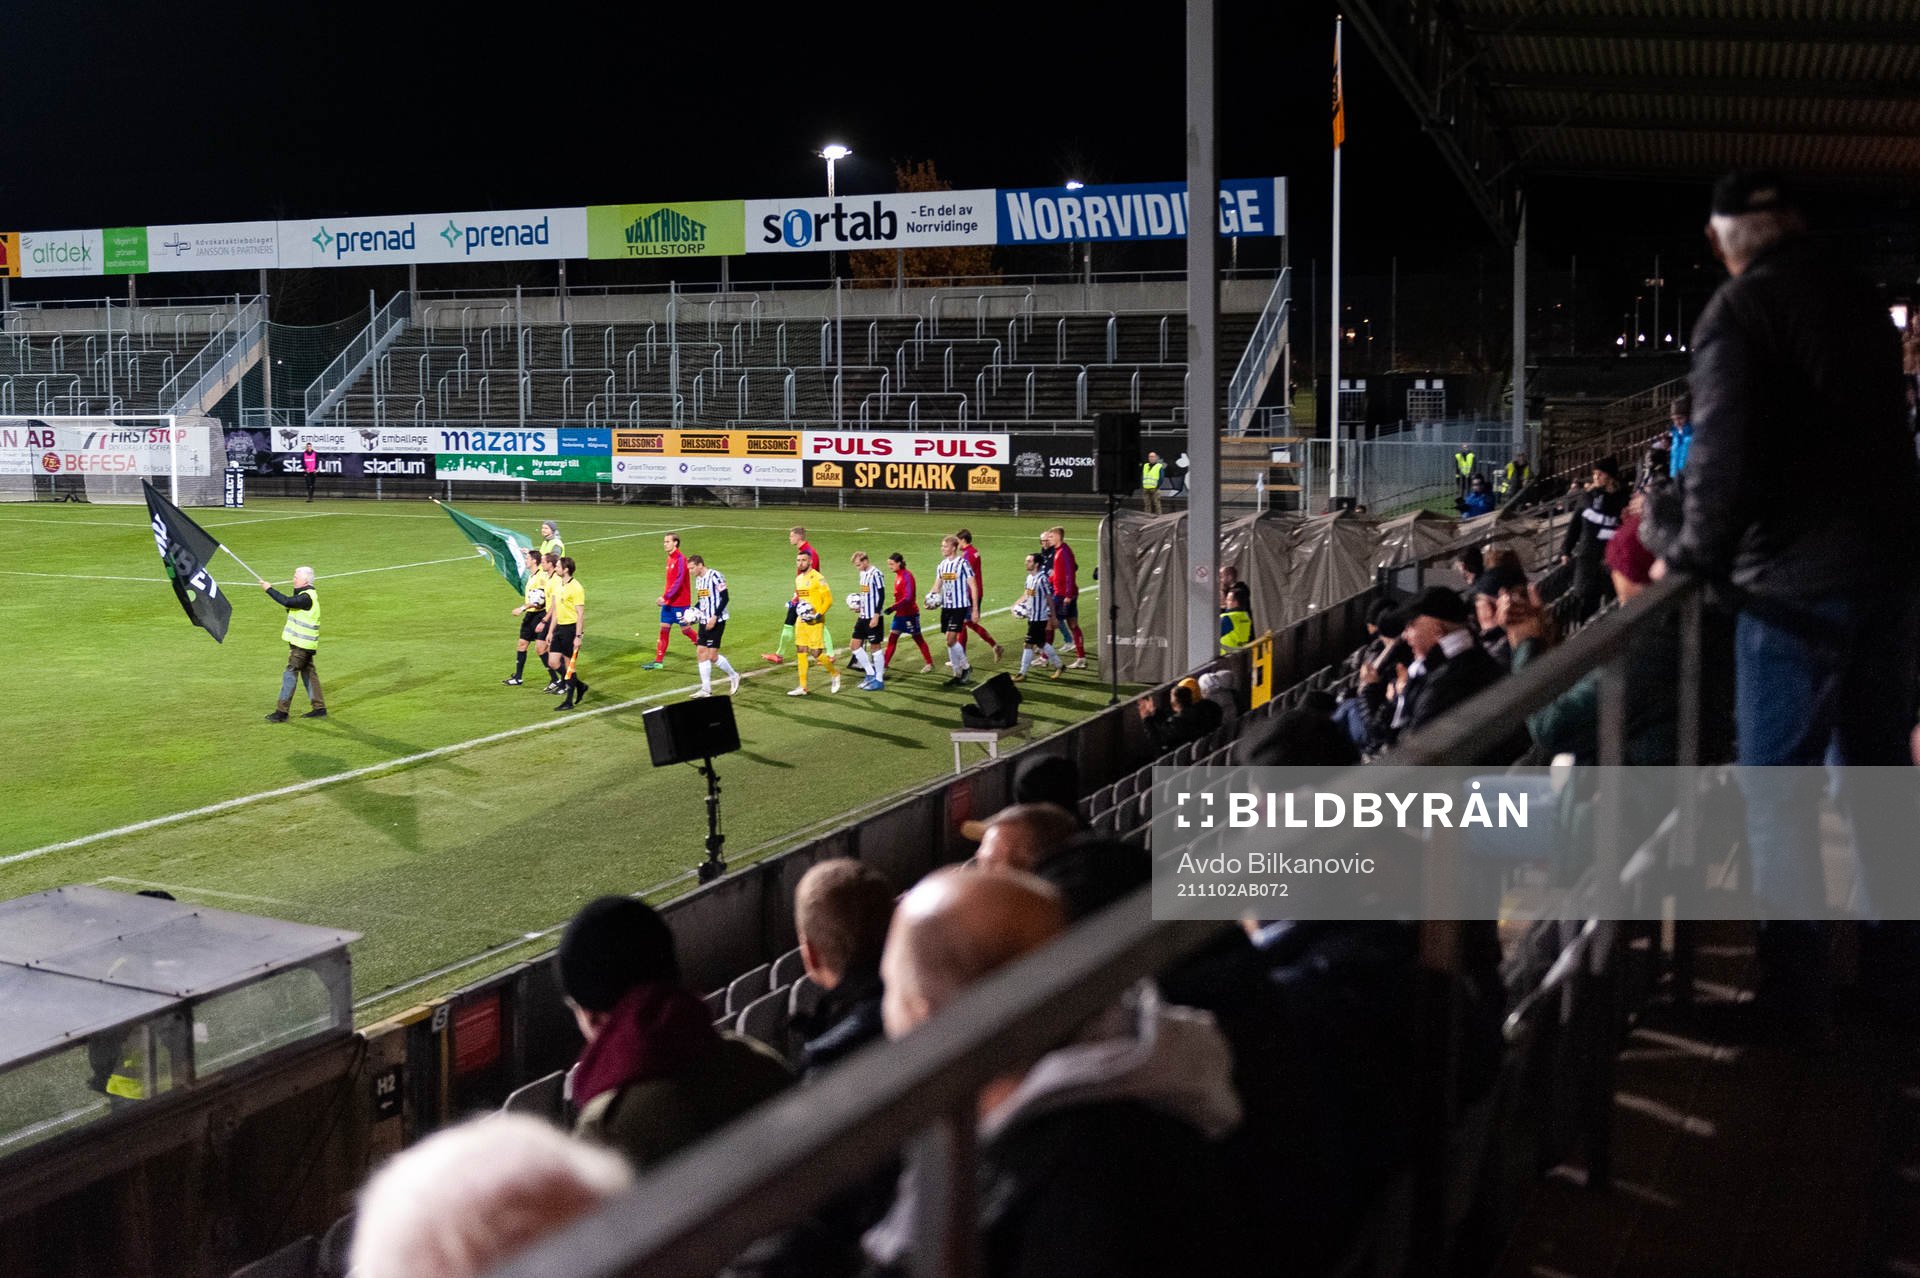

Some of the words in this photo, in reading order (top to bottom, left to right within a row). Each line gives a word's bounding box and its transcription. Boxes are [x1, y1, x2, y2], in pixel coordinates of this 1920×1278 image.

[919, 205, 934, 217] En
[937, 204, 955, 216] del
[959, 206, 974, 215] av
[1006, 190, 1264, 241] NORRVIDIGE
[625, 208, 707, 244] VÄXTHUSET
[763, 201, 897, 247] sortab
[906, 220, 978, 235] Norrvidinge
[336, 221, 415, 260] prenad
[465, 216, 549, 255] prenad
[32, 241, 92, 264] alfdex
[627, 244, 705, 256] TULLSTORP
[0, 430, 18, 448] N
[25, 430, 55, 448] AB
[441, 430, 546, 452] mazars
[617, 438, 656, 448] OHLSSONS
[681, 438, 721, 449] OHLSSONS
[747, 440, 788, 450] OHLSSONS
[813, 437, 893, 455] PULS
[914, 439, 997, 458] PULS
[65, 454, 137, 472] BEFESA
[363, 457, 425, 474] stadium
[815, 472, 841, 481] CHARK
[854, 462, 881, 488] SP
[885, 463, 956, 490] CHARK
[971, 476, 997, 485] CHARK
[1050, 469, 1073, 478] STAD
[226, 474, 235, 504] SELECT
[236, 473, 244, 504] SELECT
[377, 1074, 396, 1096] H2
